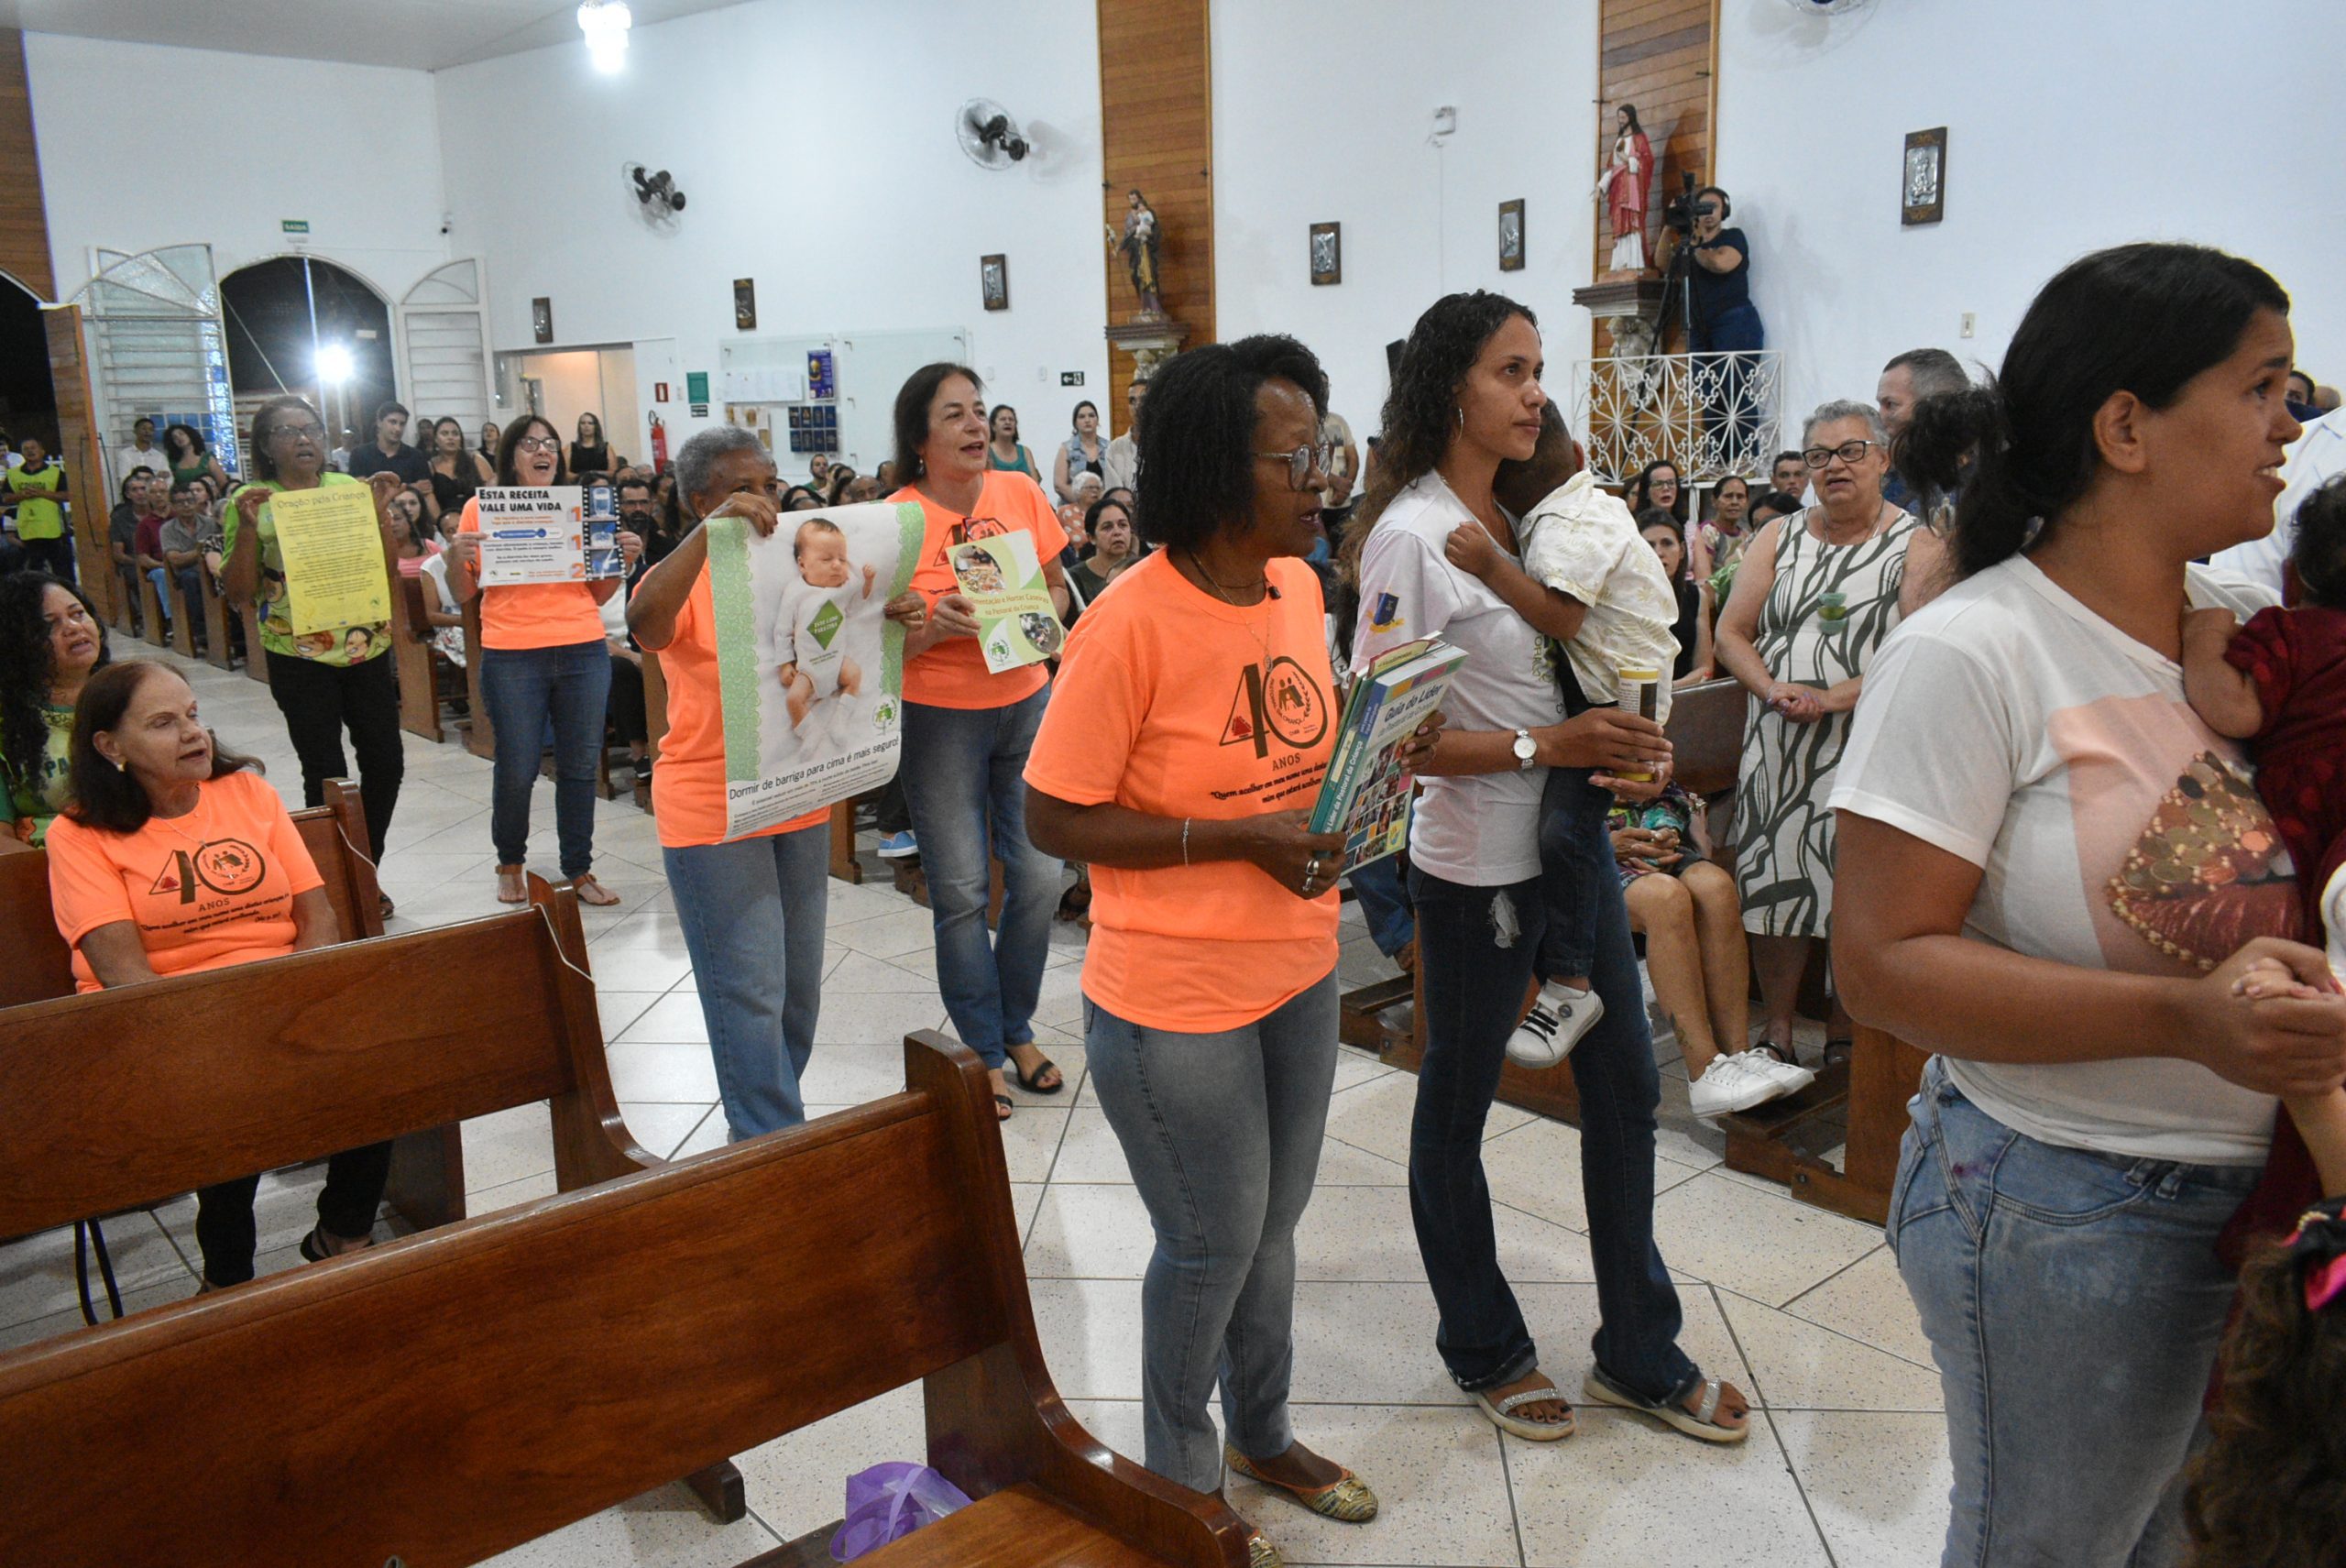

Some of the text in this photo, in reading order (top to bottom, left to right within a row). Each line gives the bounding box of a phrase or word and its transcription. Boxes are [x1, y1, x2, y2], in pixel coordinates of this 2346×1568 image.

[479, 489, 550, 499] ESTA RECEITA
[479, 502, 562, 512] VALE UMA VIDA
[570, 507, 581, 522] 1
[570, 534, 581, 551] 1
[570, 563, 586, 578] 2
[1219, 656, 1328, 759] 40
[1272, 752, 1301, 771] ANOS
[1349, 740, 1364, 766] Criança
[729, 782, 759, 800] Dormir
[762, 777, 773, 790] de
[775, 770, 805, 787] barriga
[806, 762, 825, 778] para
[826, 757, 845, 770] cima
[846, 751, 852, 762] é
[853, 747, 872, 761] mais
[872, 736, 900, 753] seguro!
[1346, 765, 1353, 775] da
[1336, 774, 1352, 801] Pastoral
[149, 838, 266, 905] 40
[199, 898, 230, 912] ANOS
